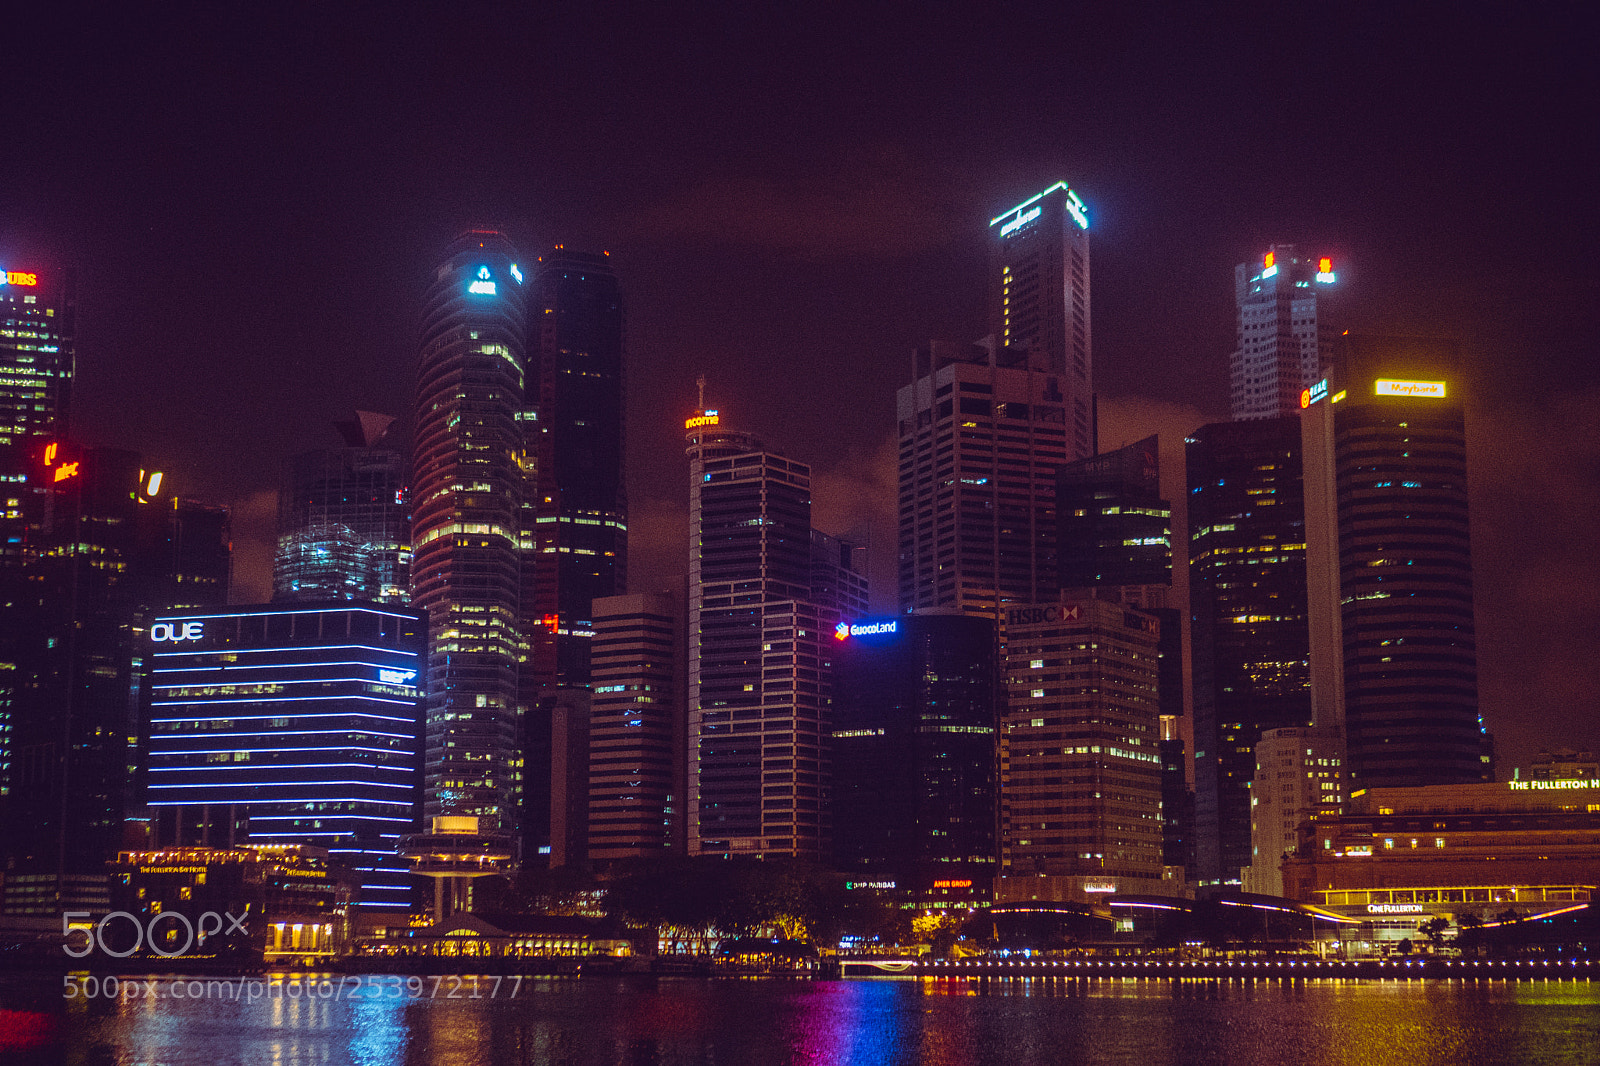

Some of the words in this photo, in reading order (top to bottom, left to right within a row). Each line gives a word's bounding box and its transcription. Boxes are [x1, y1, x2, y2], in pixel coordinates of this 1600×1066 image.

[7, 271, 37, 286] UBS
[1391, 383, 1438, 395] Maybank
[1009, 606, 1057, 625] HSBC
[151, 621, 204, 641] OUE
[1508, 780, 1529, 790] THE
[1531, 780, 1588, 790] FULLERTON
[951, 880, 973, 888] GROUP
[1384, 904, 1423, 913] FULLERTON
